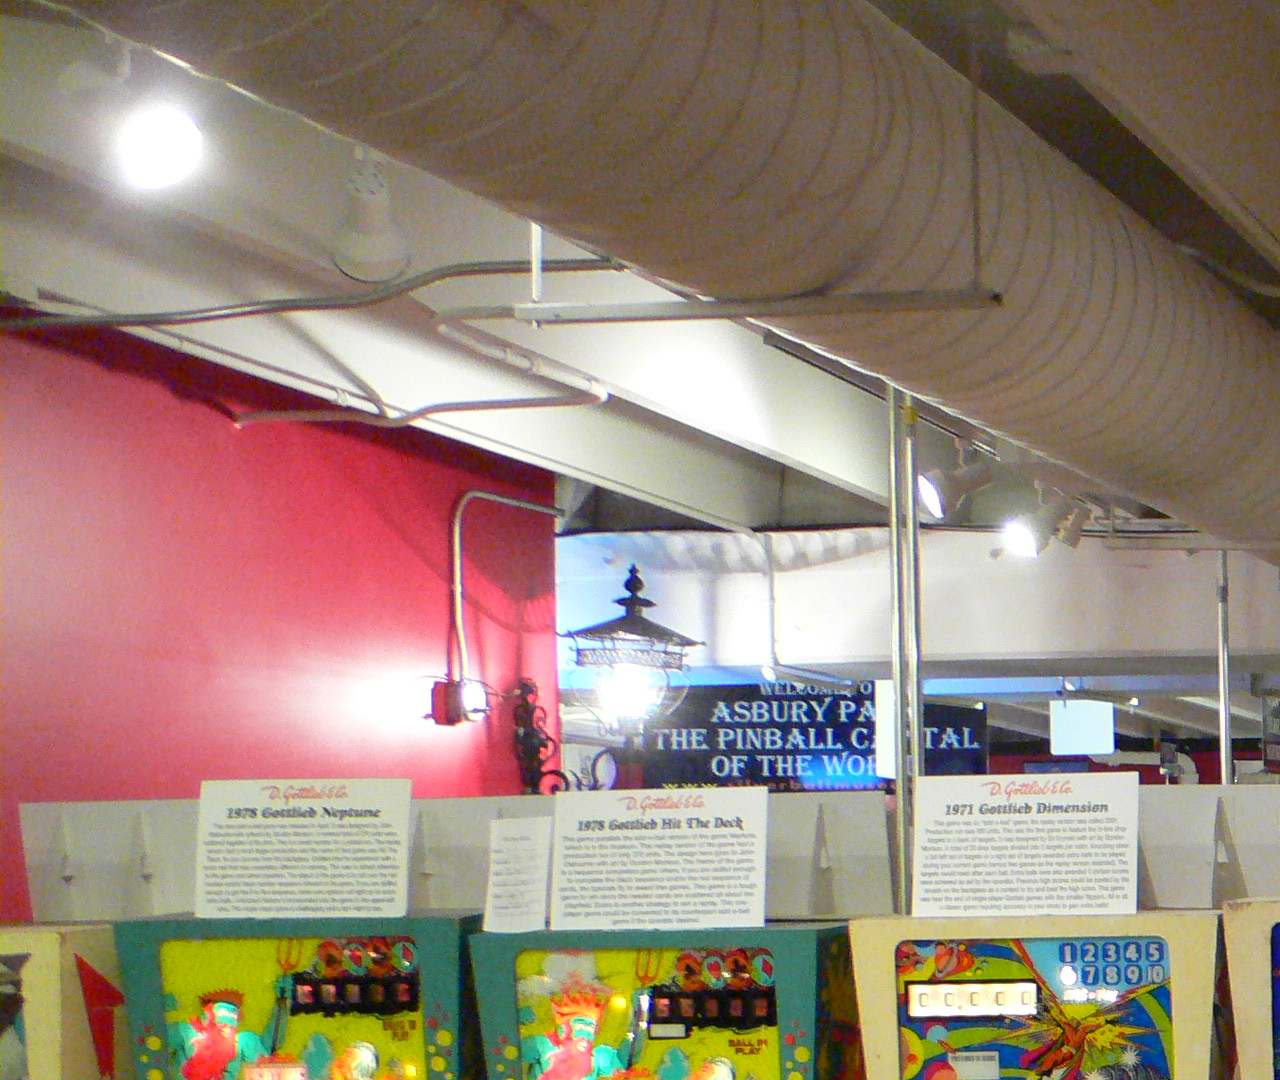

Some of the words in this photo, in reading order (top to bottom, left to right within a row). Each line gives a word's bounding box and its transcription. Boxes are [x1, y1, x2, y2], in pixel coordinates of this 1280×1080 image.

[711, 697, 833, 723] ASBURY
[652, 729, 709, 750] THE
[718, 728, 843, 750] PINBALL
[711, 755, 747, 777] OF
[756, 755, 813, 777] THE
[262, 806, 316, 819] Gottlieb
[321, 807, 382, 821] Neptune
[945, 803, 974, 816] 1971
[978, 803, 1032, 816] Gottlieb
[1036, 801, 1109, 815] Dimension
[609, 818, 657, 832] Gottlieb
[661, 818, 682, 830] Hit
[686, 817, 710, 830] The
[714, 816, 744, 831] Deck
[1064, 945, 1072, 962] 1
[1084, 944, 1095, 962] 2
[1104, 944, 1116, 962] 3
[1126, 943, 1139, 961] 4
[1149, 943, 1160, 961] 5
[1085, 966, 1096, 984] 7
[1106, 966, 1118, 983] 8
[1127, 966, 1140, 983] 9
[1147, 966, 1164, 983] 10
[735, 1047, 761, 1055] PLAY
